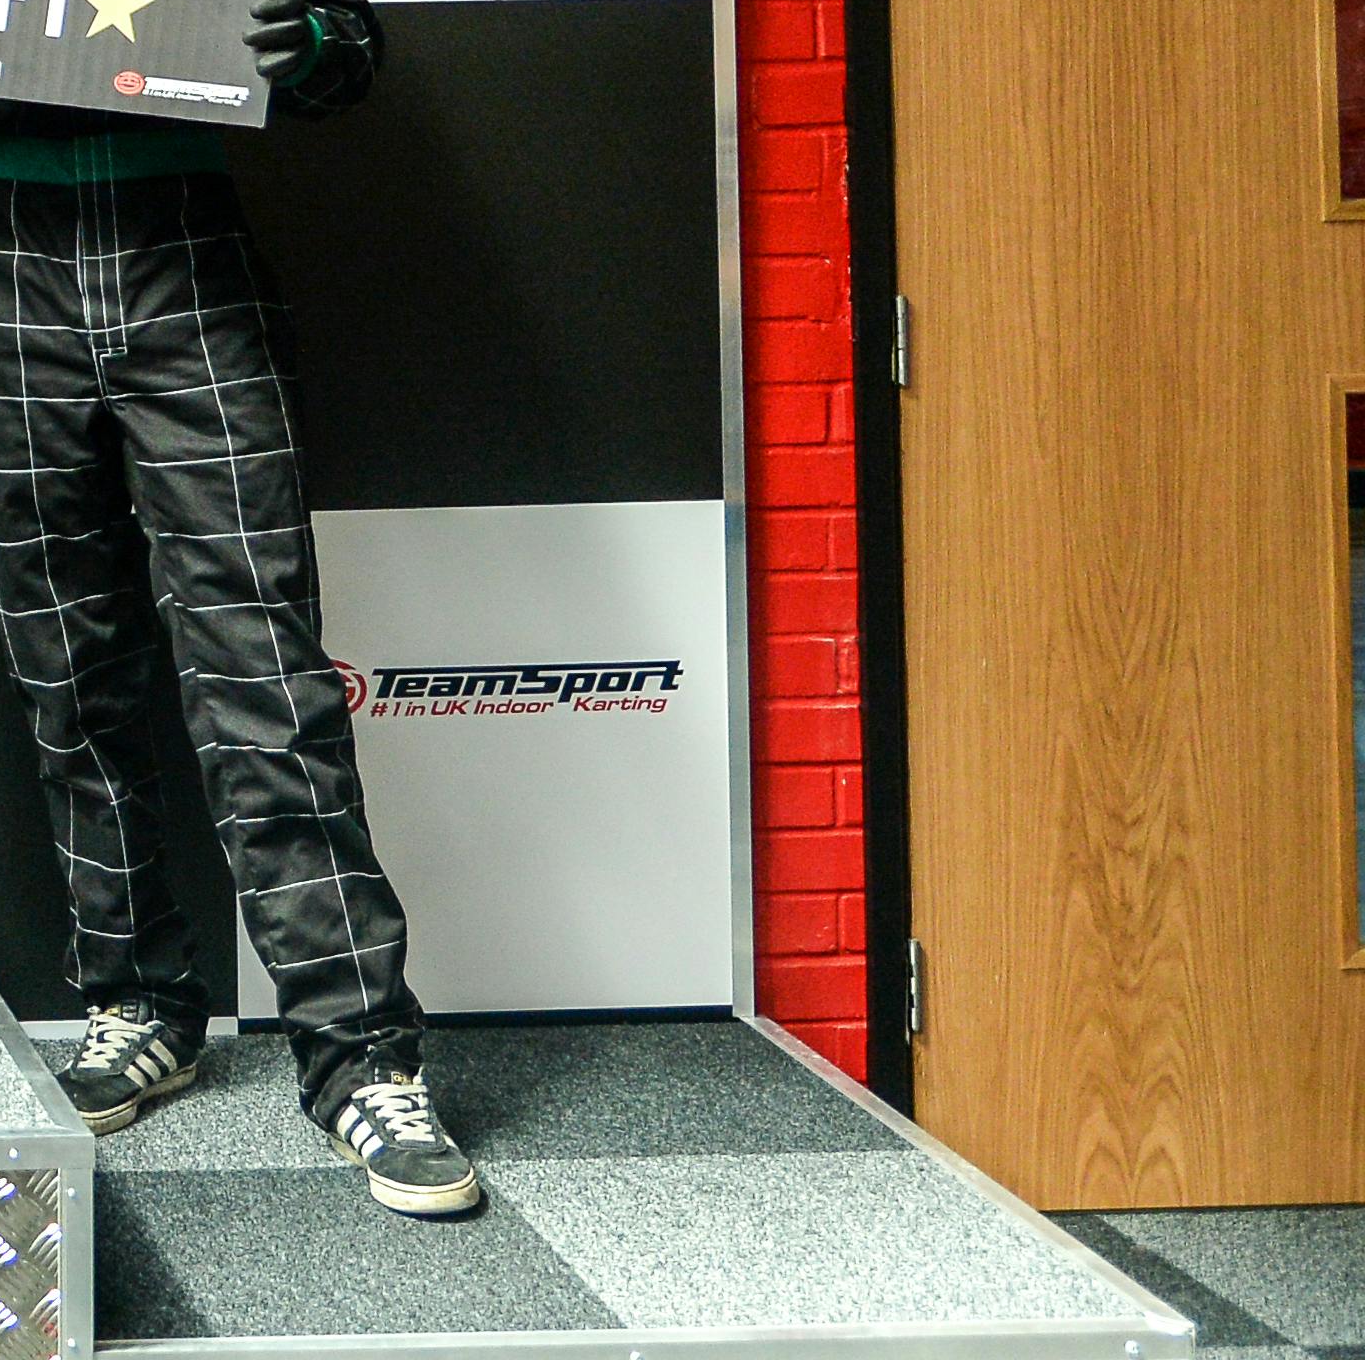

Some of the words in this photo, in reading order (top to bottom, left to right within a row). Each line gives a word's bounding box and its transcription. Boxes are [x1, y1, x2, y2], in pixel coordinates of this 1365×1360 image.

[371, 660, 684, 703] TeamSport
[430, 700, 469, 717] UK
[473, 699, 554, 716] Indoor
[573, 696, 668, 714] Karting
